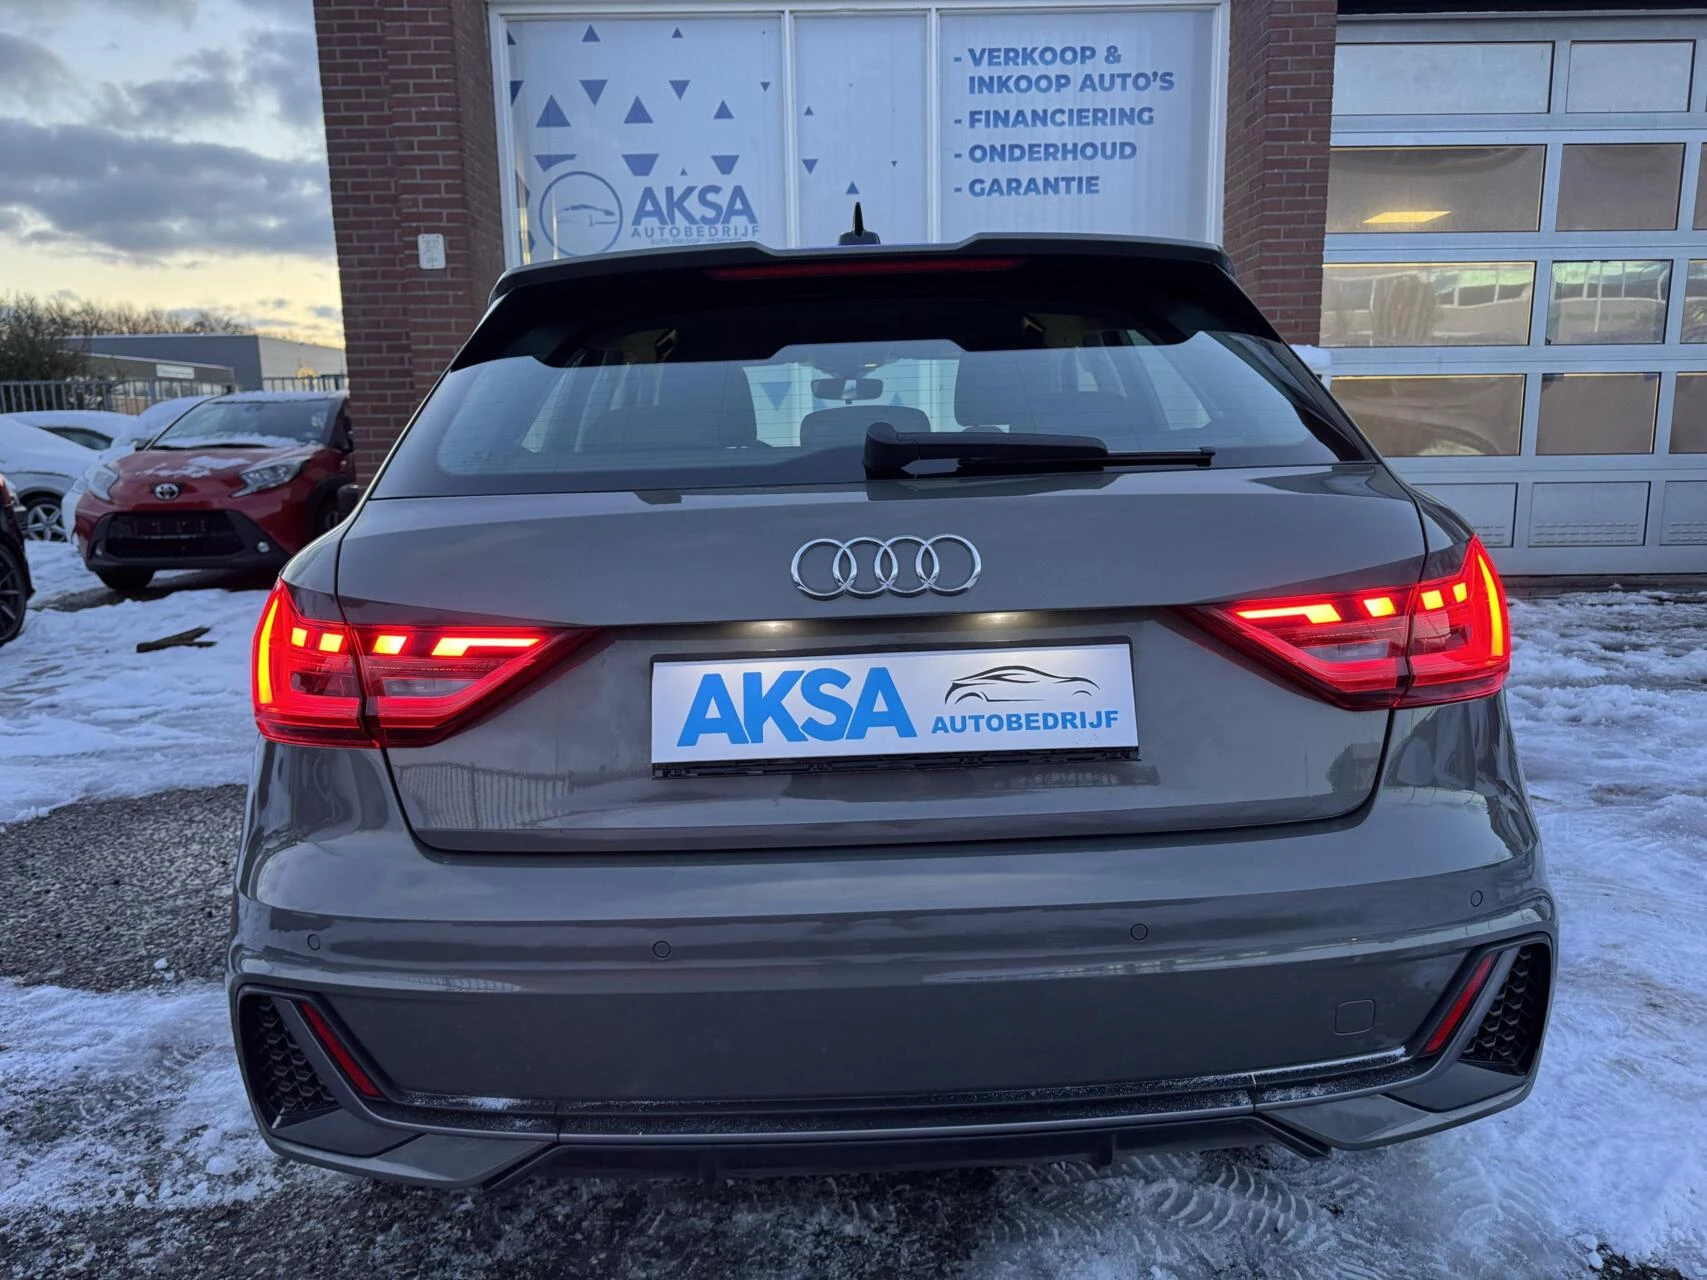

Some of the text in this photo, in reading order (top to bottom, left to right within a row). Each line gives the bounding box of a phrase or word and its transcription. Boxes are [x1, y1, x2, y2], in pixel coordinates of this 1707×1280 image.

[967, 45, 1097, 67] VERKOOP
[1104, 45, 1122, 65] &
[968, 71, 1175, 95] INKOOP AUTO'S
[968, 106, 1155, 129] FINANCIERING
[967, 141, 1138, 164] ONDERHOUD
[967, 175, 1100, 198] GARANTIE
[631, 184, 759, 226] AKSA
[631, 225, 760, 238] AUTOBEDRIJF
[676, 666, 918, 747] AKSA
[931, 709, 1119, 735] AUTOBEDRIJF
